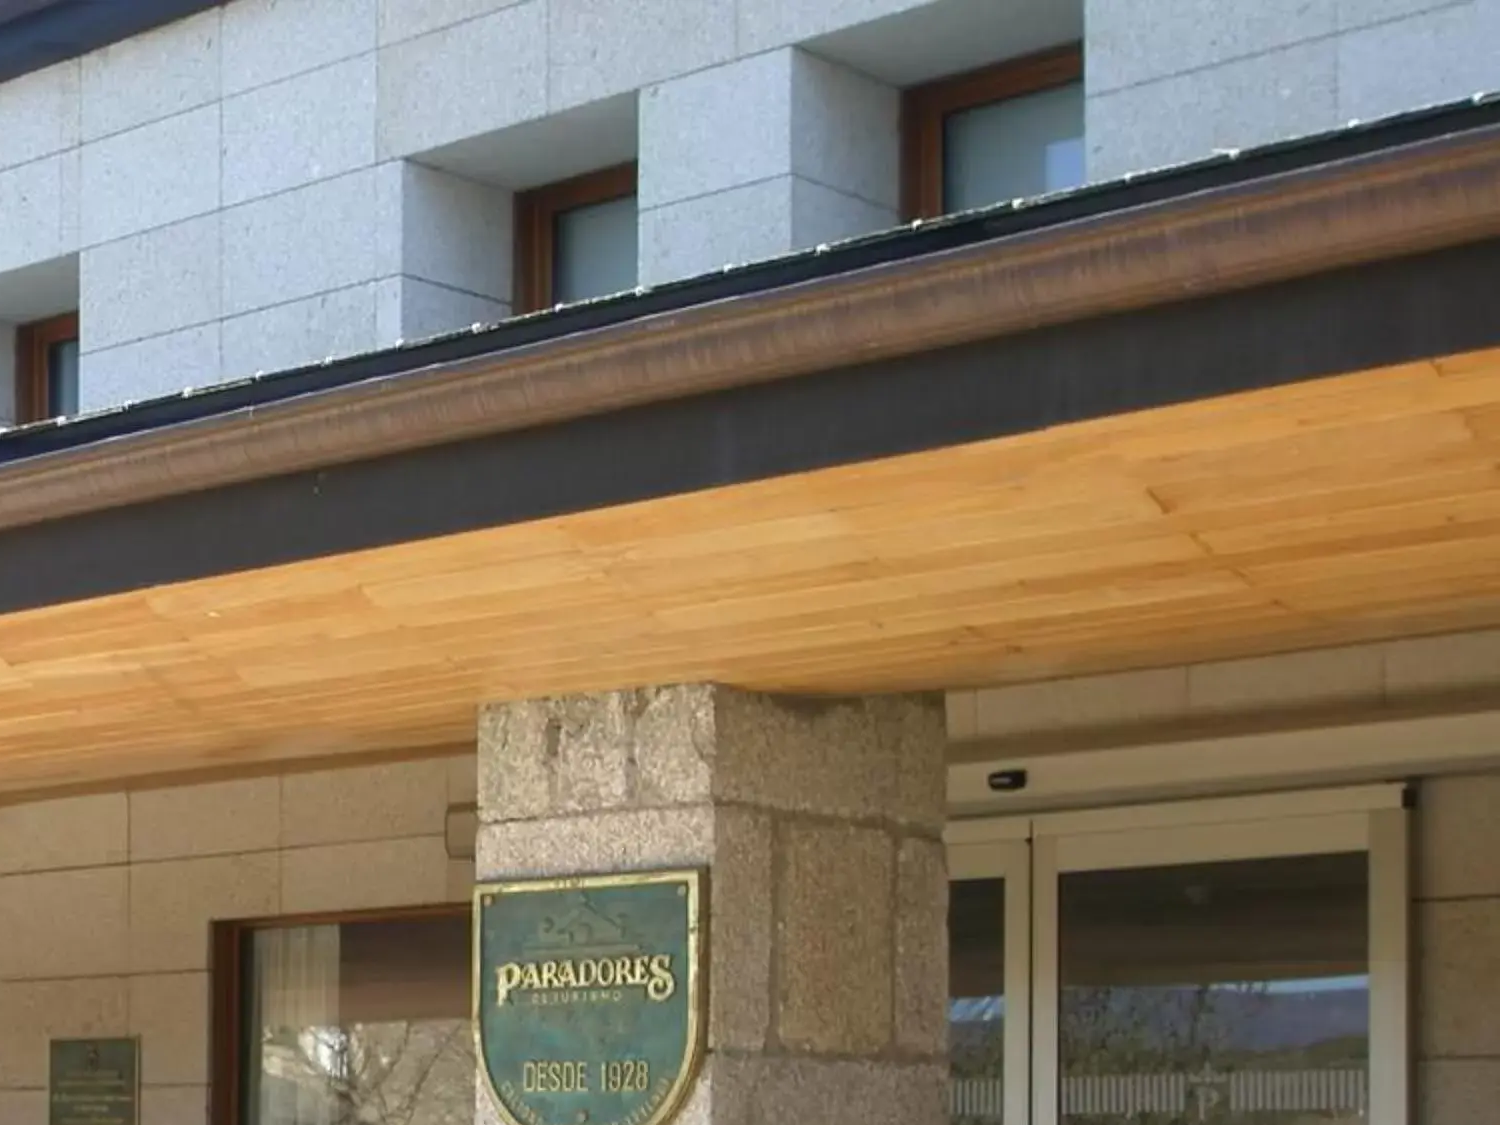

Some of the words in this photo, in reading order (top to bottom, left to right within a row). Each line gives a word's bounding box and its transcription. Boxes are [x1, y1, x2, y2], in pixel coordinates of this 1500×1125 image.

[496, 953, 676, 1008] PARADORES
[522, 1061, 589, 1092] DESDE
[600, 1059, 650, 1091] 1928
